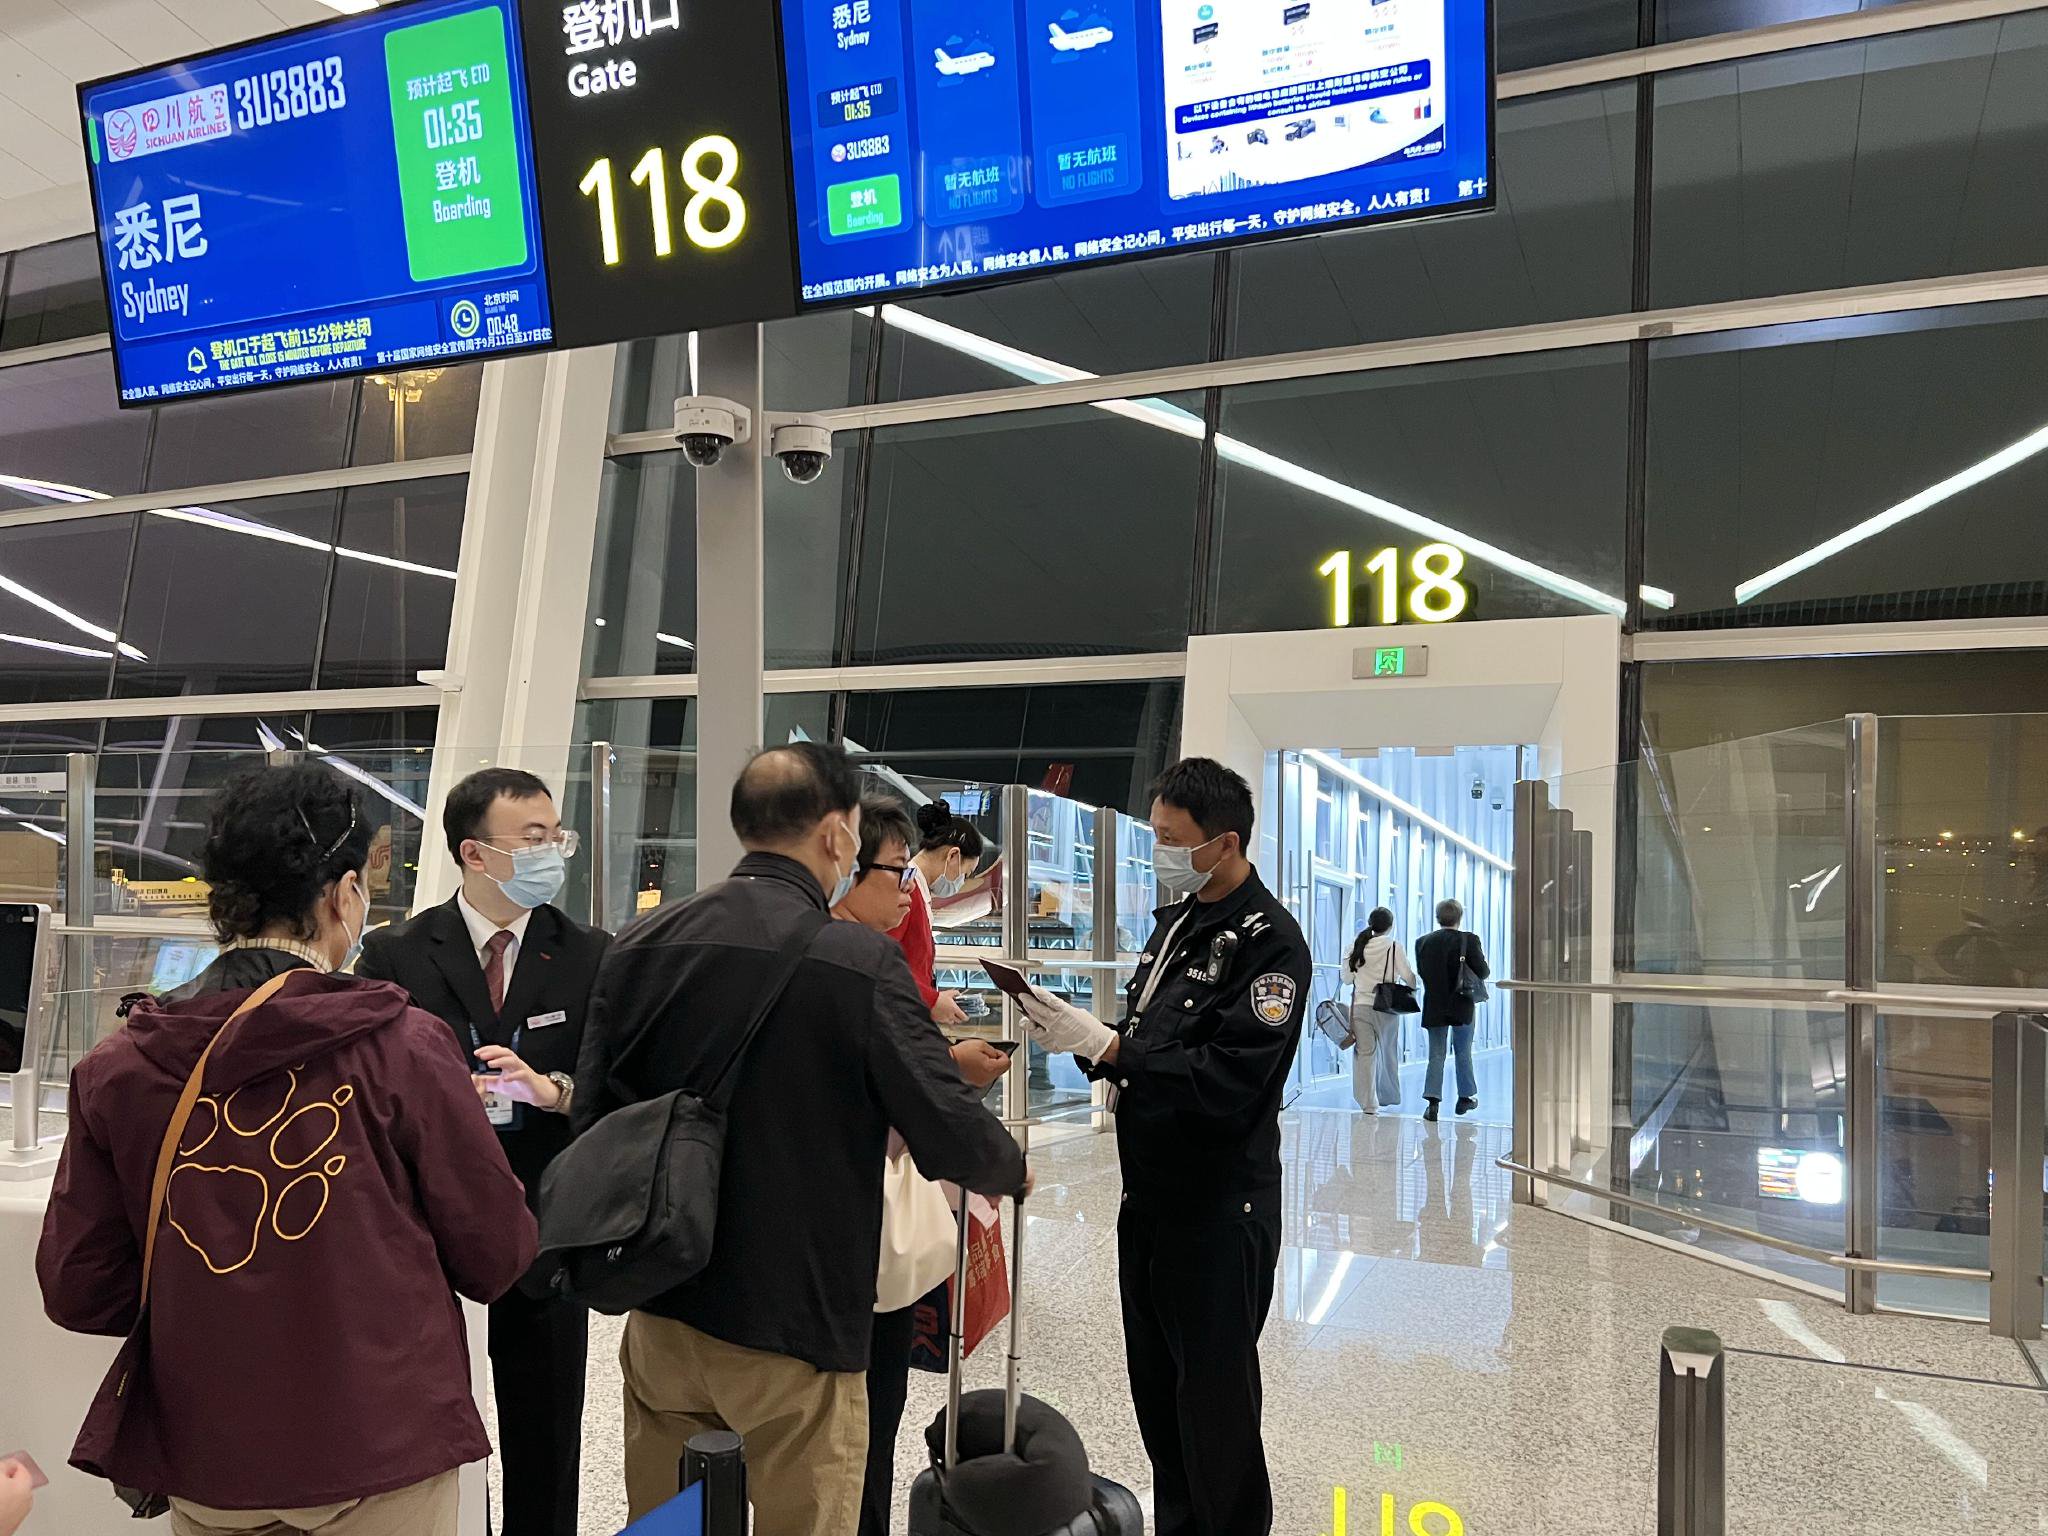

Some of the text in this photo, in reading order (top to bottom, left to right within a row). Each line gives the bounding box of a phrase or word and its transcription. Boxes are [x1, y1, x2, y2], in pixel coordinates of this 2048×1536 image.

[562, 0, 679, 55] 登机口
[832, 0, 871, 30] 悉尼
[837, 30, 870, 50] Sydney
[234, 56, 346, 130] 3U3883
[406, 63, 490, 100] 预计起飞 ETD
[568, 59, 637, 98] Gate
[142, 89, 225, 132] 四川航空
[424, 99, 483, 149] 01:35
[844, 100, 871, 121] 01:35
[145, 122, 228, 149] SICHUAN AIRLINES
[846, 134, 890, 161] 3U3883
[1057, 145, 1117, 171] 暂无航班
[435, 156, 481, 191] 登机
[944, 166, 1000, 191] 暂无航班
[1062, 167, 1115, 190] NO FLIGHTS
[1457, 177, 1488, 198] 第十
[432, 193, 492, 223] Boarding
[578, 134, 746, 266] 118
[850, 188, 877, 209] 登机
[963, 188, 998, 209] FLIGHTS
[114, 193, 208, 270] 悉尼
[846, 210, 884, 229] Boarding
[121, 278, 189, 324] Sydney
[483, 289, 519, 306] 北京时间
[210, 317, 372, 360] 登机口于起飞前15分钟关闭
[486, 313, 519, 336] 00:48
[1317, 542, 1468, 627] 118
